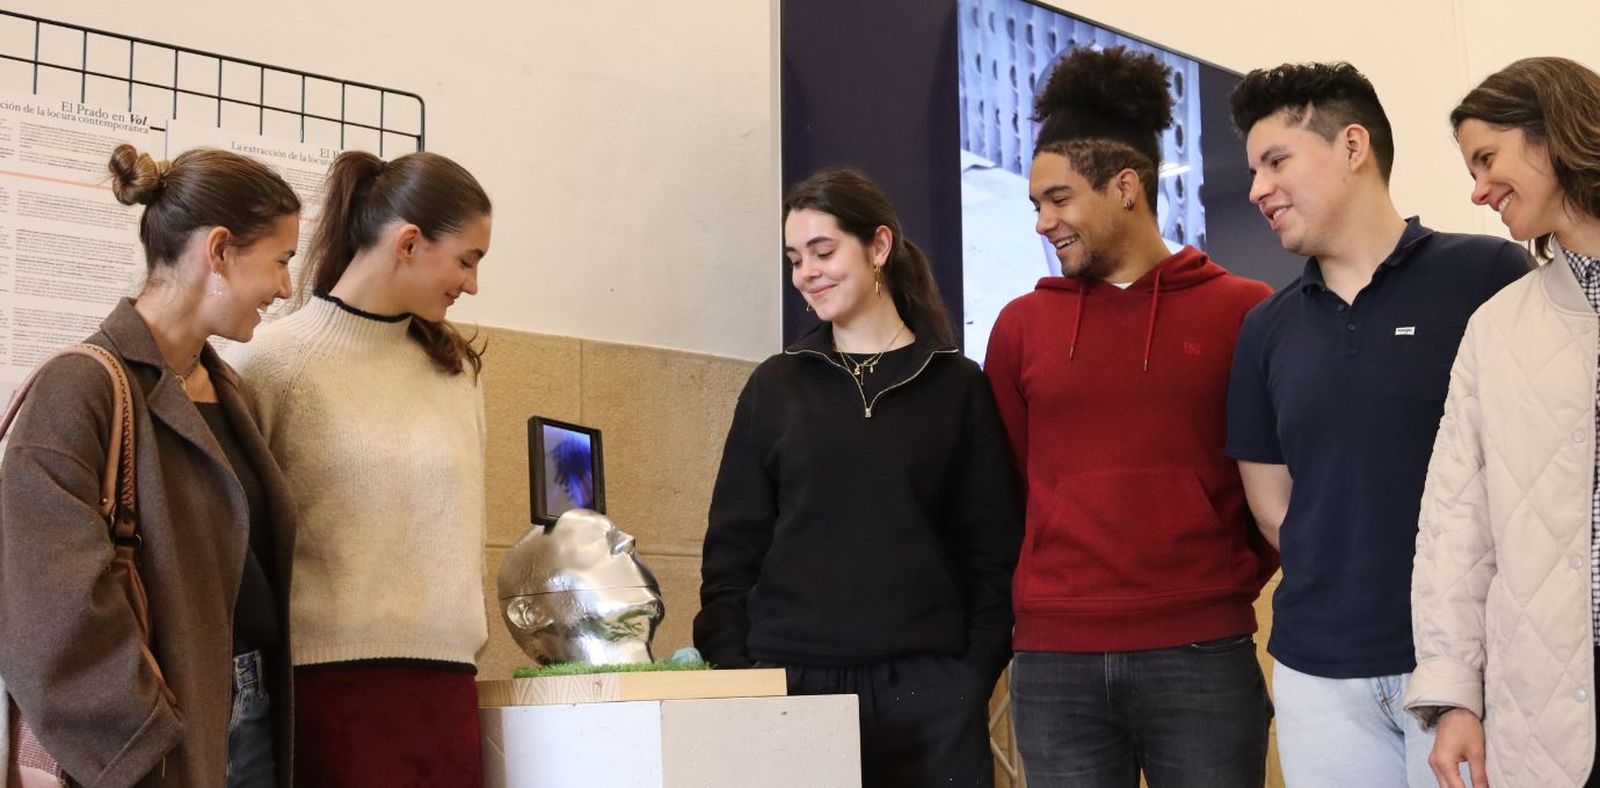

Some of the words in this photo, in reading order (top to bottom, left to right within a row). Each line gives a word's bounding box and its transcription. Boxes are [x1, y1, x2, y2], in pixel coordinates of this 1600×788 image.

[23, 104, 35, 114] de
[37, 105, 45, 116] la
[47, 107, 76, 121] locura
[61, 100, 73, 113] El
[76, 103, 109, 120] Prado
[112, 114, 125, 123] en
[231, 140, 242, 151] La
[288, 151, 299, 160] de
[300, 152, 307, 163] la
[320, 147, 330, 158] El
